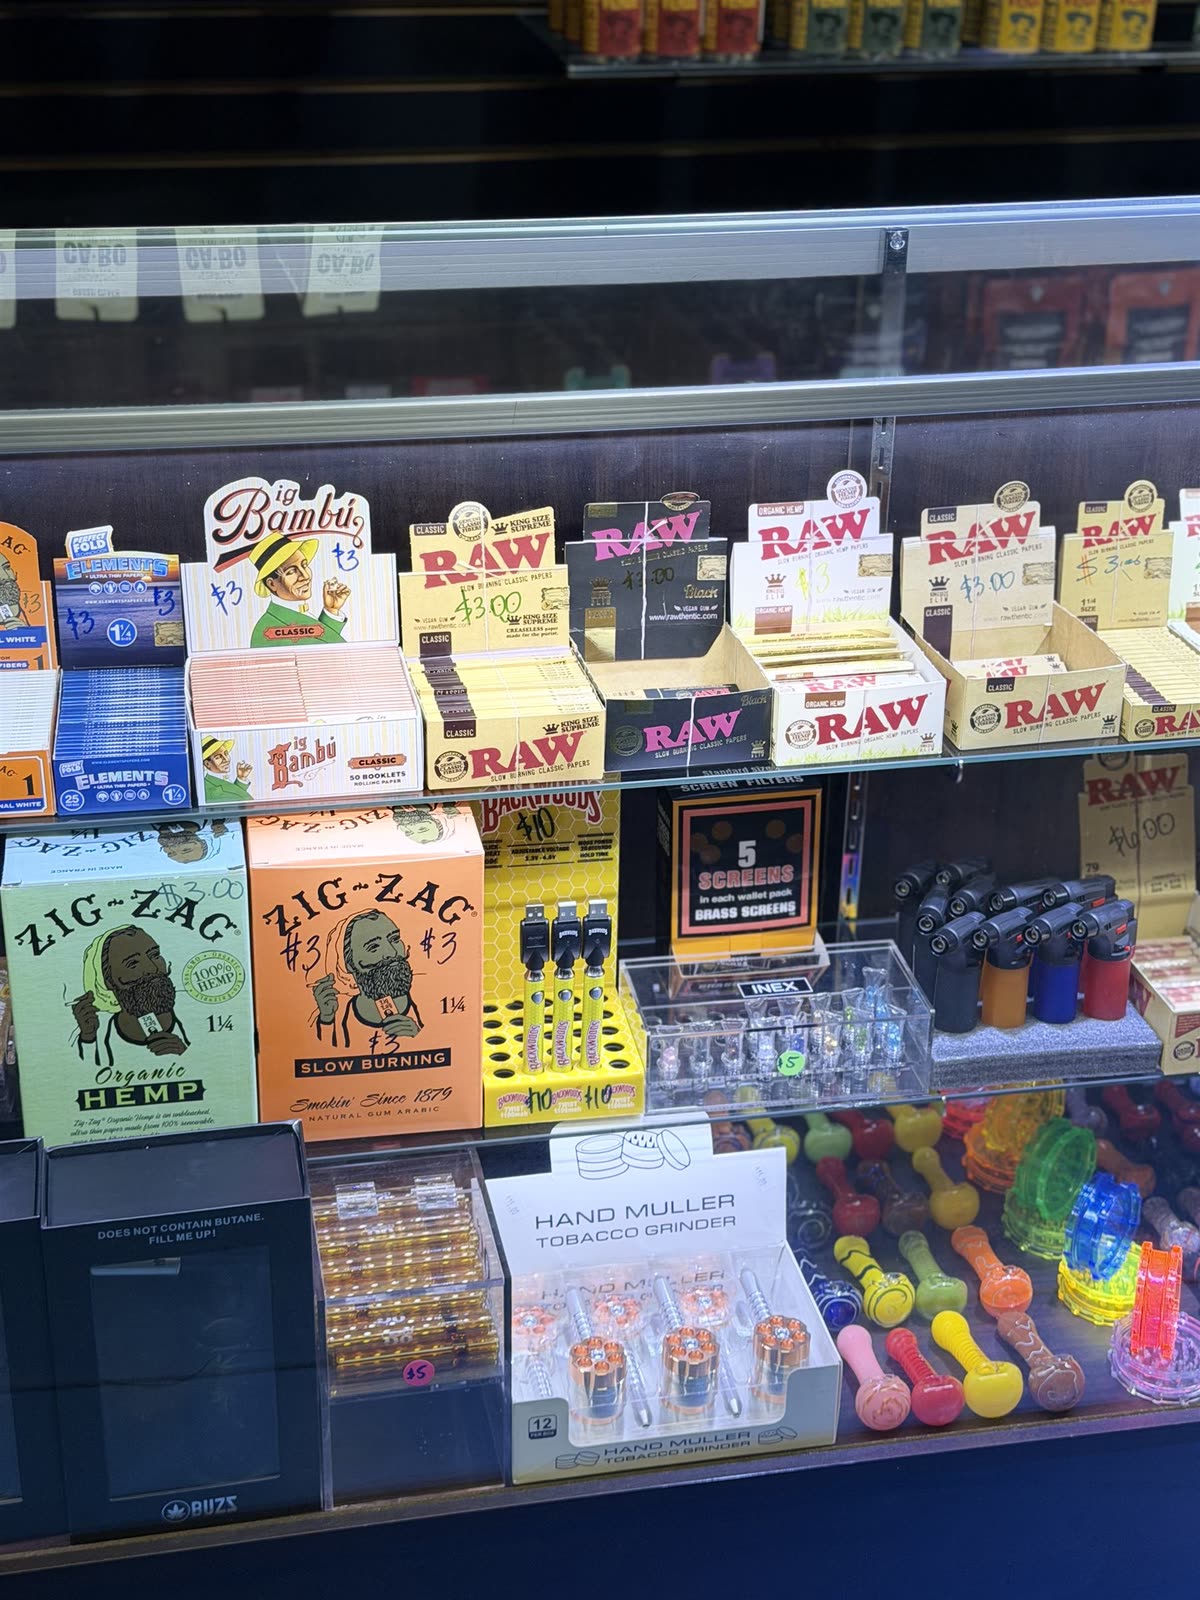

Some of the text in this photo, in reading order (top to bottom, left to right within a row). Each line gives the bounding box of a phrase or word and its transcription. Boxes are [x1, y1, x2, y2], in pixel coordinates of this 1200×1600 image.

[759, 505, 803, 515] ORGANIC HEMP
[929, 514, 955, 522] CLASSIC
[510, 514, 550, 526] KING SIZE
[511, 521, 551, 533] SUPREME
[416, 525, 445, 534] CLASSIC
[592, 511, 701, 561] RAW
[758, 509, 870, 560] RAW
[1082, 514, 1157, 548] RAW
[73, 533, 105, 544] PERFECT
[926, 511, 1035, 565] RAW
[73, 540, 106, 553] FOLD
[419, 532, 551, 589] RAW
[66, 558, 169, 580] ELEMENTS
[505, 576, 528, 585] CLASSIC
[531, 572, 552, 580] PAPERS
[684, 584, 718, 598] Black
[960, 571, 1015, 603] $3.00
[211, 580, 243, 616] $3
[650, 613, 718, 621] www.rawthentic.com
[926, 608, 951, 617] CLASSIC
[275, 628, 315, 636] CLASSIC
[421, 635, 450, 644] CLASSIC
[988, 683, 1013, 692] CLASSIC
[806, 700, 828, 708] ORGANIC
[1004, 682, 1107, 729] RAW
[1153, 705, 1175, 713] CLASSIC
[560, 719, 580, 727] KING
[561, 722, 600, 732] SUPREME
[815, 694, 928, 745] RAW
[1030, 721, 1052, 733] BURNNG
[1055, 717, 1078, 728] CLASSIC
[1081, 712, 1101, 722] PAPERS
[446, 729, 474, 737] CLASSIC
[643, 710, 740, 752] RAW
[864, 735, 884, 744] ORGANIC
[886, 732, 899, 740] HEMP
[901, 728, 919, 736] PAPERS
[359, 757, 397, 766] CLASSIC
[468, 731, 584, 779] RAW
[363, 771, 406, 780] BOOKLETS
[491, 760, 591, 782] SLOW BURNING CLASSIC PAPERS
[22, 774, 35, 796] 1
[75, 770, 169, 790] ELEMENTS
[681, 776, 804, 792] SCREEN FILTERS
[1087, 765, 1180, 806] RAW
[65, 795, 79, 803] 25
[517, 807, 555, 841] $10
[738, 840, 756, 868] 5
[1086, 863, 1099, 872] 79
[699, 865, 794, 890] SCREENS
[700, 888, 792, 904] in each wallet pack
[695, 901, 796, 921] BRASS SCREENS
[193, 962, 232, 982] 100%
[197, 972, 234, 992] HEMP
[751, 980, 799, 994] INEX
[301, 1052, 446, 1074] SLOW BURNING
[95, 1062, 186, 1087] Organic
[83, 1082, 198, 1110] HEMP
[289, 1086, 453, 1113] Smokin' Since 1879
[107, 1115, 133, 1123] Organic
[308, 1106, 440, 1122] NATURAL GUM ARABIC
[71, 1128, 88, 1136] ultra
[89, 1127, 102, 1135] thin
[142, 1122, 159, 1131] from
[535, 1194, 735, 1230] HAND MULLER
[97, 1212, 265, 1240] DOES NOT CONTAIN BUTANE.
[536, 1215, 737, 1249] TOBACCO GRINDER
[149, 1230, 216, 1245] FILL ME UP!
[407, 1364, 427, 1380] $5
[534, 1418, 551, 1430] 12
[604, 1430, 751, 1456] HAND MULLER
[604, 1439, 751, 1465] TOBACCO GRINDER
